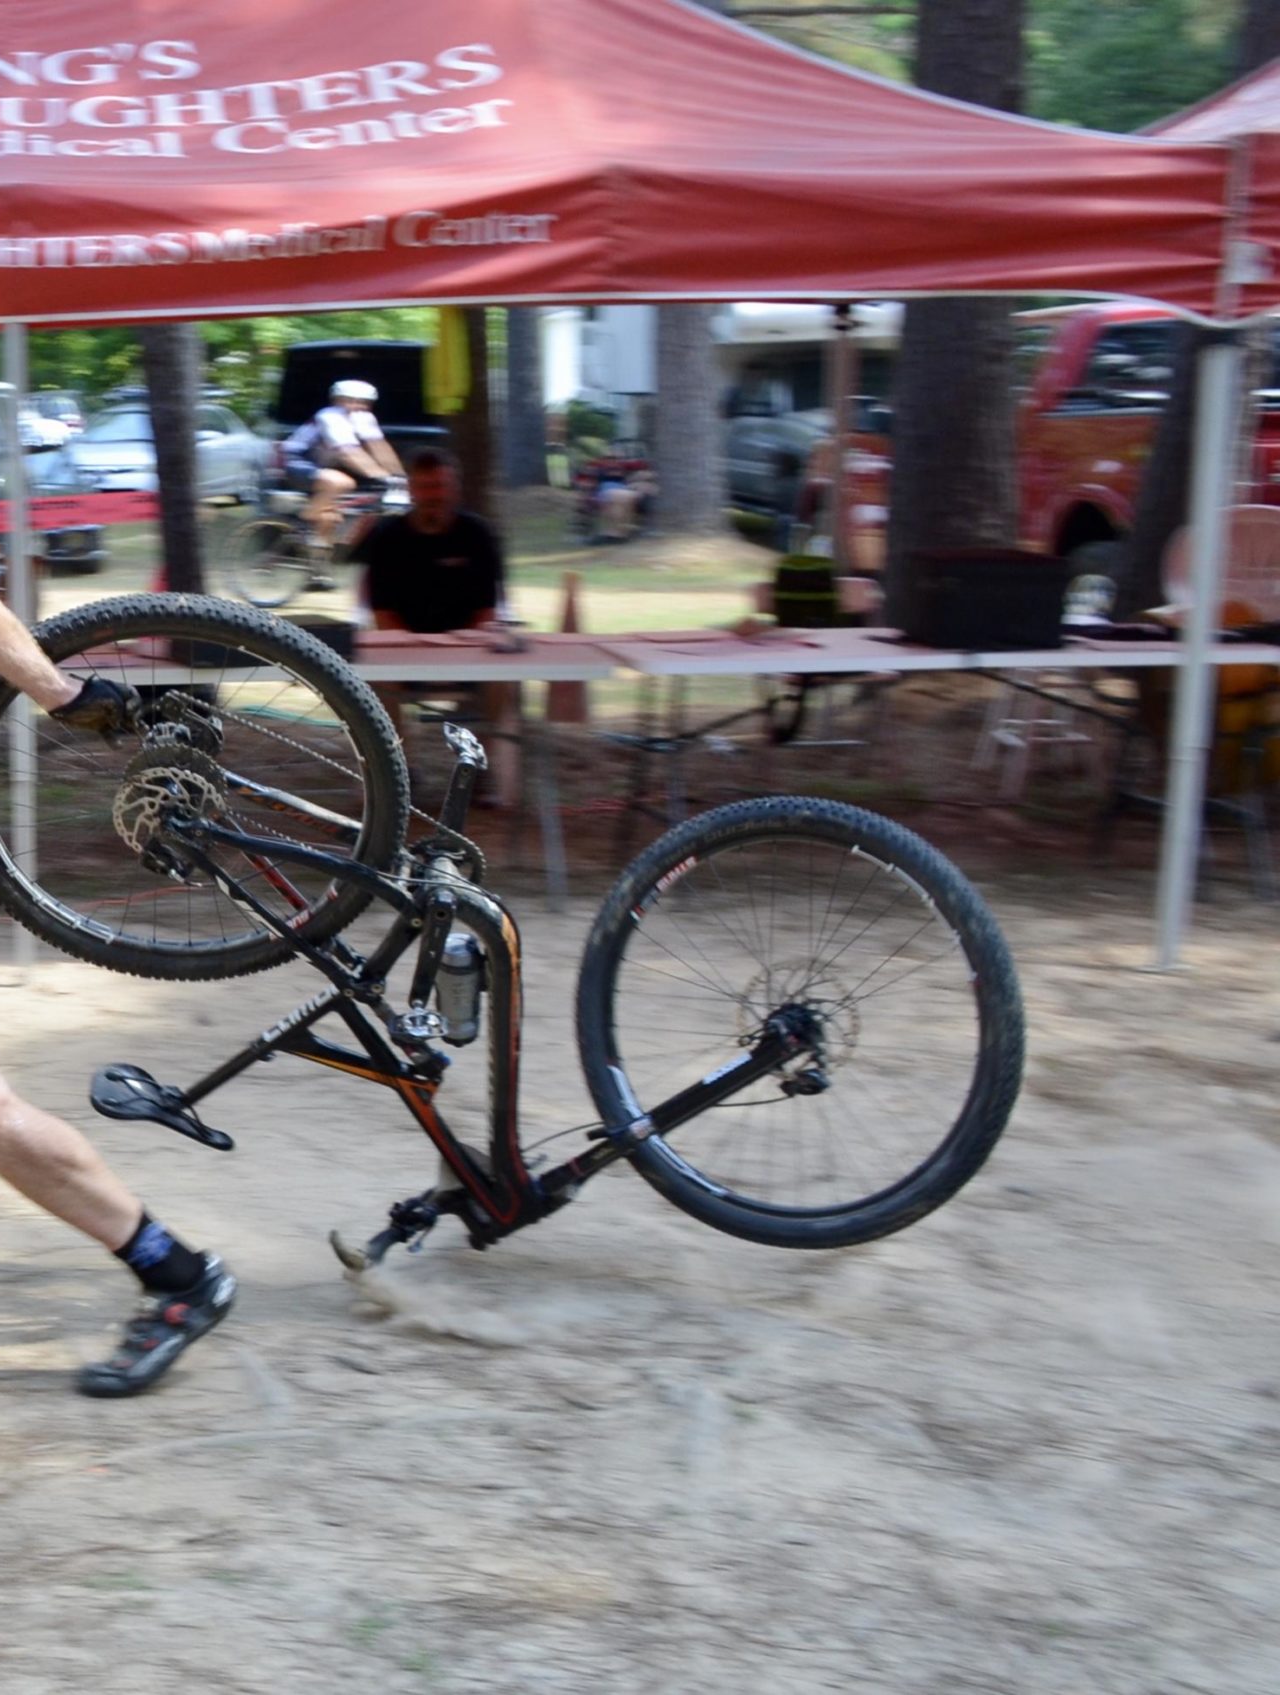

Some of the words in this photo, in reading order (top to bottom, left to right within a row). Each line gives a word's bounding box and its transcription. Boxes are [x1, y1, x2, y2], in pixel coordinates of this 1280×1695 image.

[211, 98, 515, 154] Center
[191, 214, 387, 264] Medical
[393, 210, 559, 247] Center
